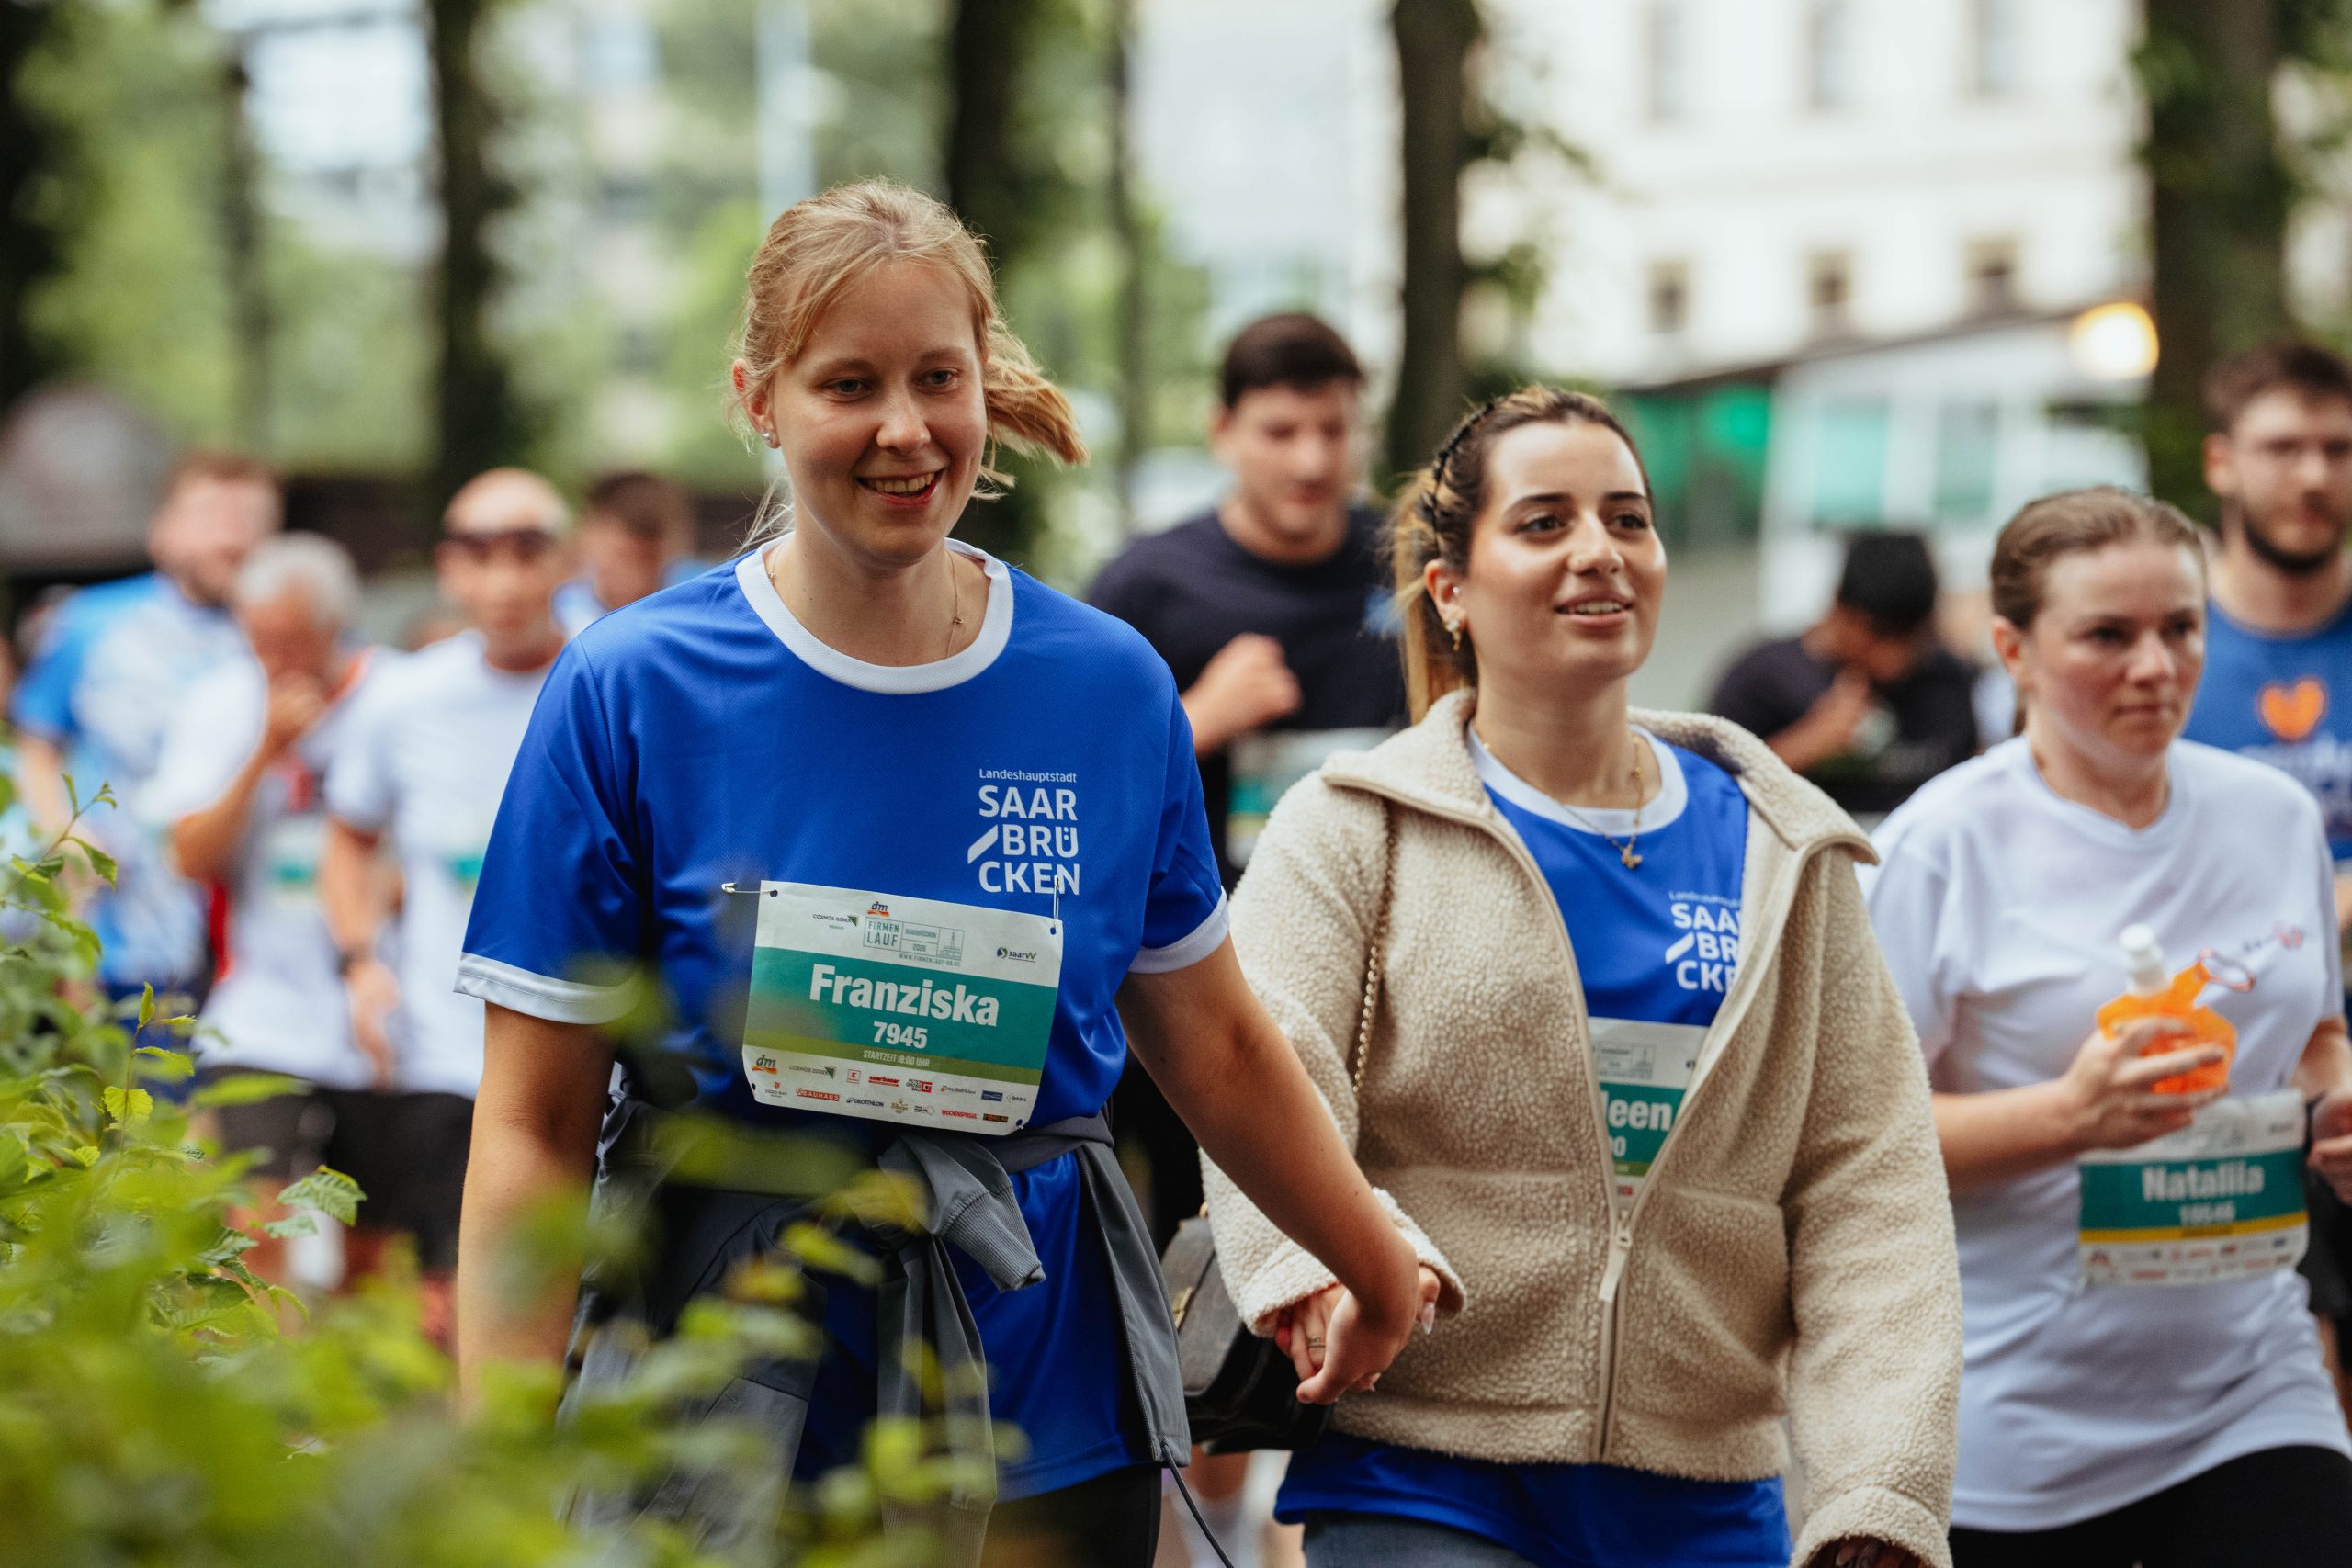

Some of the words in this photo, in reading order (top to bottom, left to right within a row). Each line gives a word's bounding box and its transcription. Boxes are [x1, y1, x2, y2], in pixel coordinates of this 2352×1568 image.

[979, 768, 1077, 783] Landeshauptstadt
[978, 784, 1078, 820] SAAR
[978, 861, 1080, 895] CKEN
[868, 921, 899, 933] FIRMEN
[1670, 902, 1740, 936] SAA
[866, 933, 899, 947] LAUF
[1696, 931, 1738, 963] BR
[809, 963, 1000, 1027] Franziska
[873, 1021, 928, 1049] 7945
[863, 1050, 898, 1063] STARTZEIT
[915, 1057, 931, 1067] UHR
